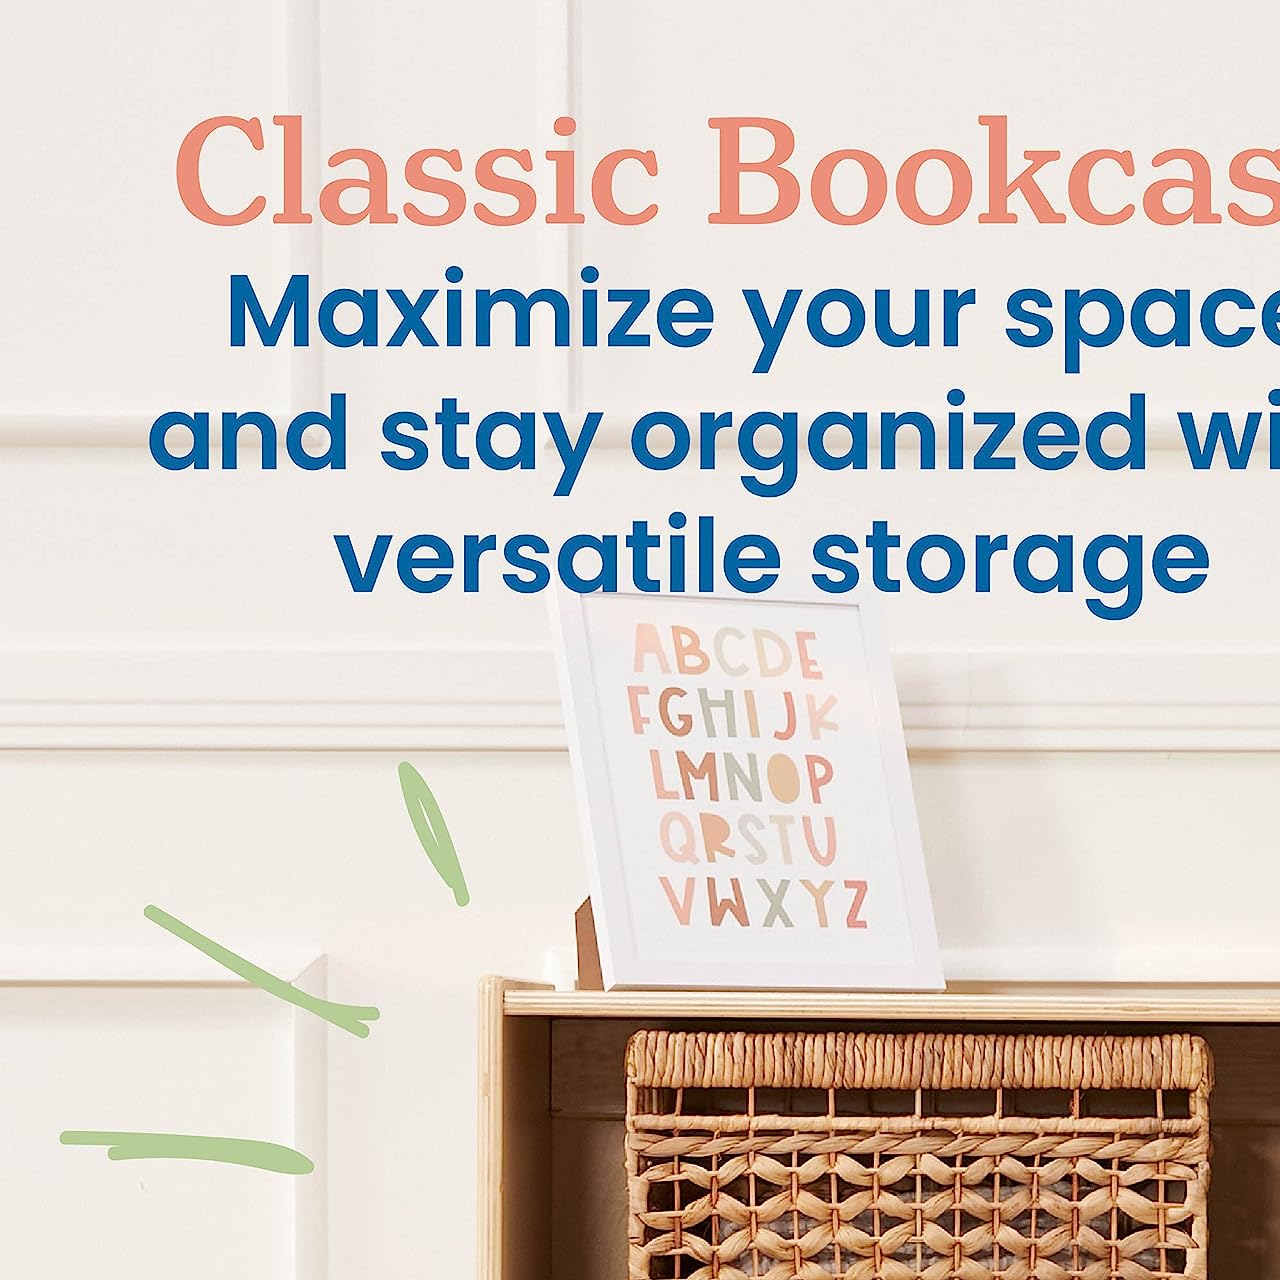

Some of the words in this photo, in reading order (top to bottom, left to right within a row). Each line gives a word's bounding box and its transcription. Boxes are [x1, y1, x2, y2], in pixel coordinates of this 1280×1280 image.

[633, 623, 824, 680] ABCDE
[626, 685, 839, 741] FGHIJK
[649, 749, 833, 804] LMNOP
[659, 811, 837, 867] QRSTU
[658, 876, 869, 929] VWXYZ
